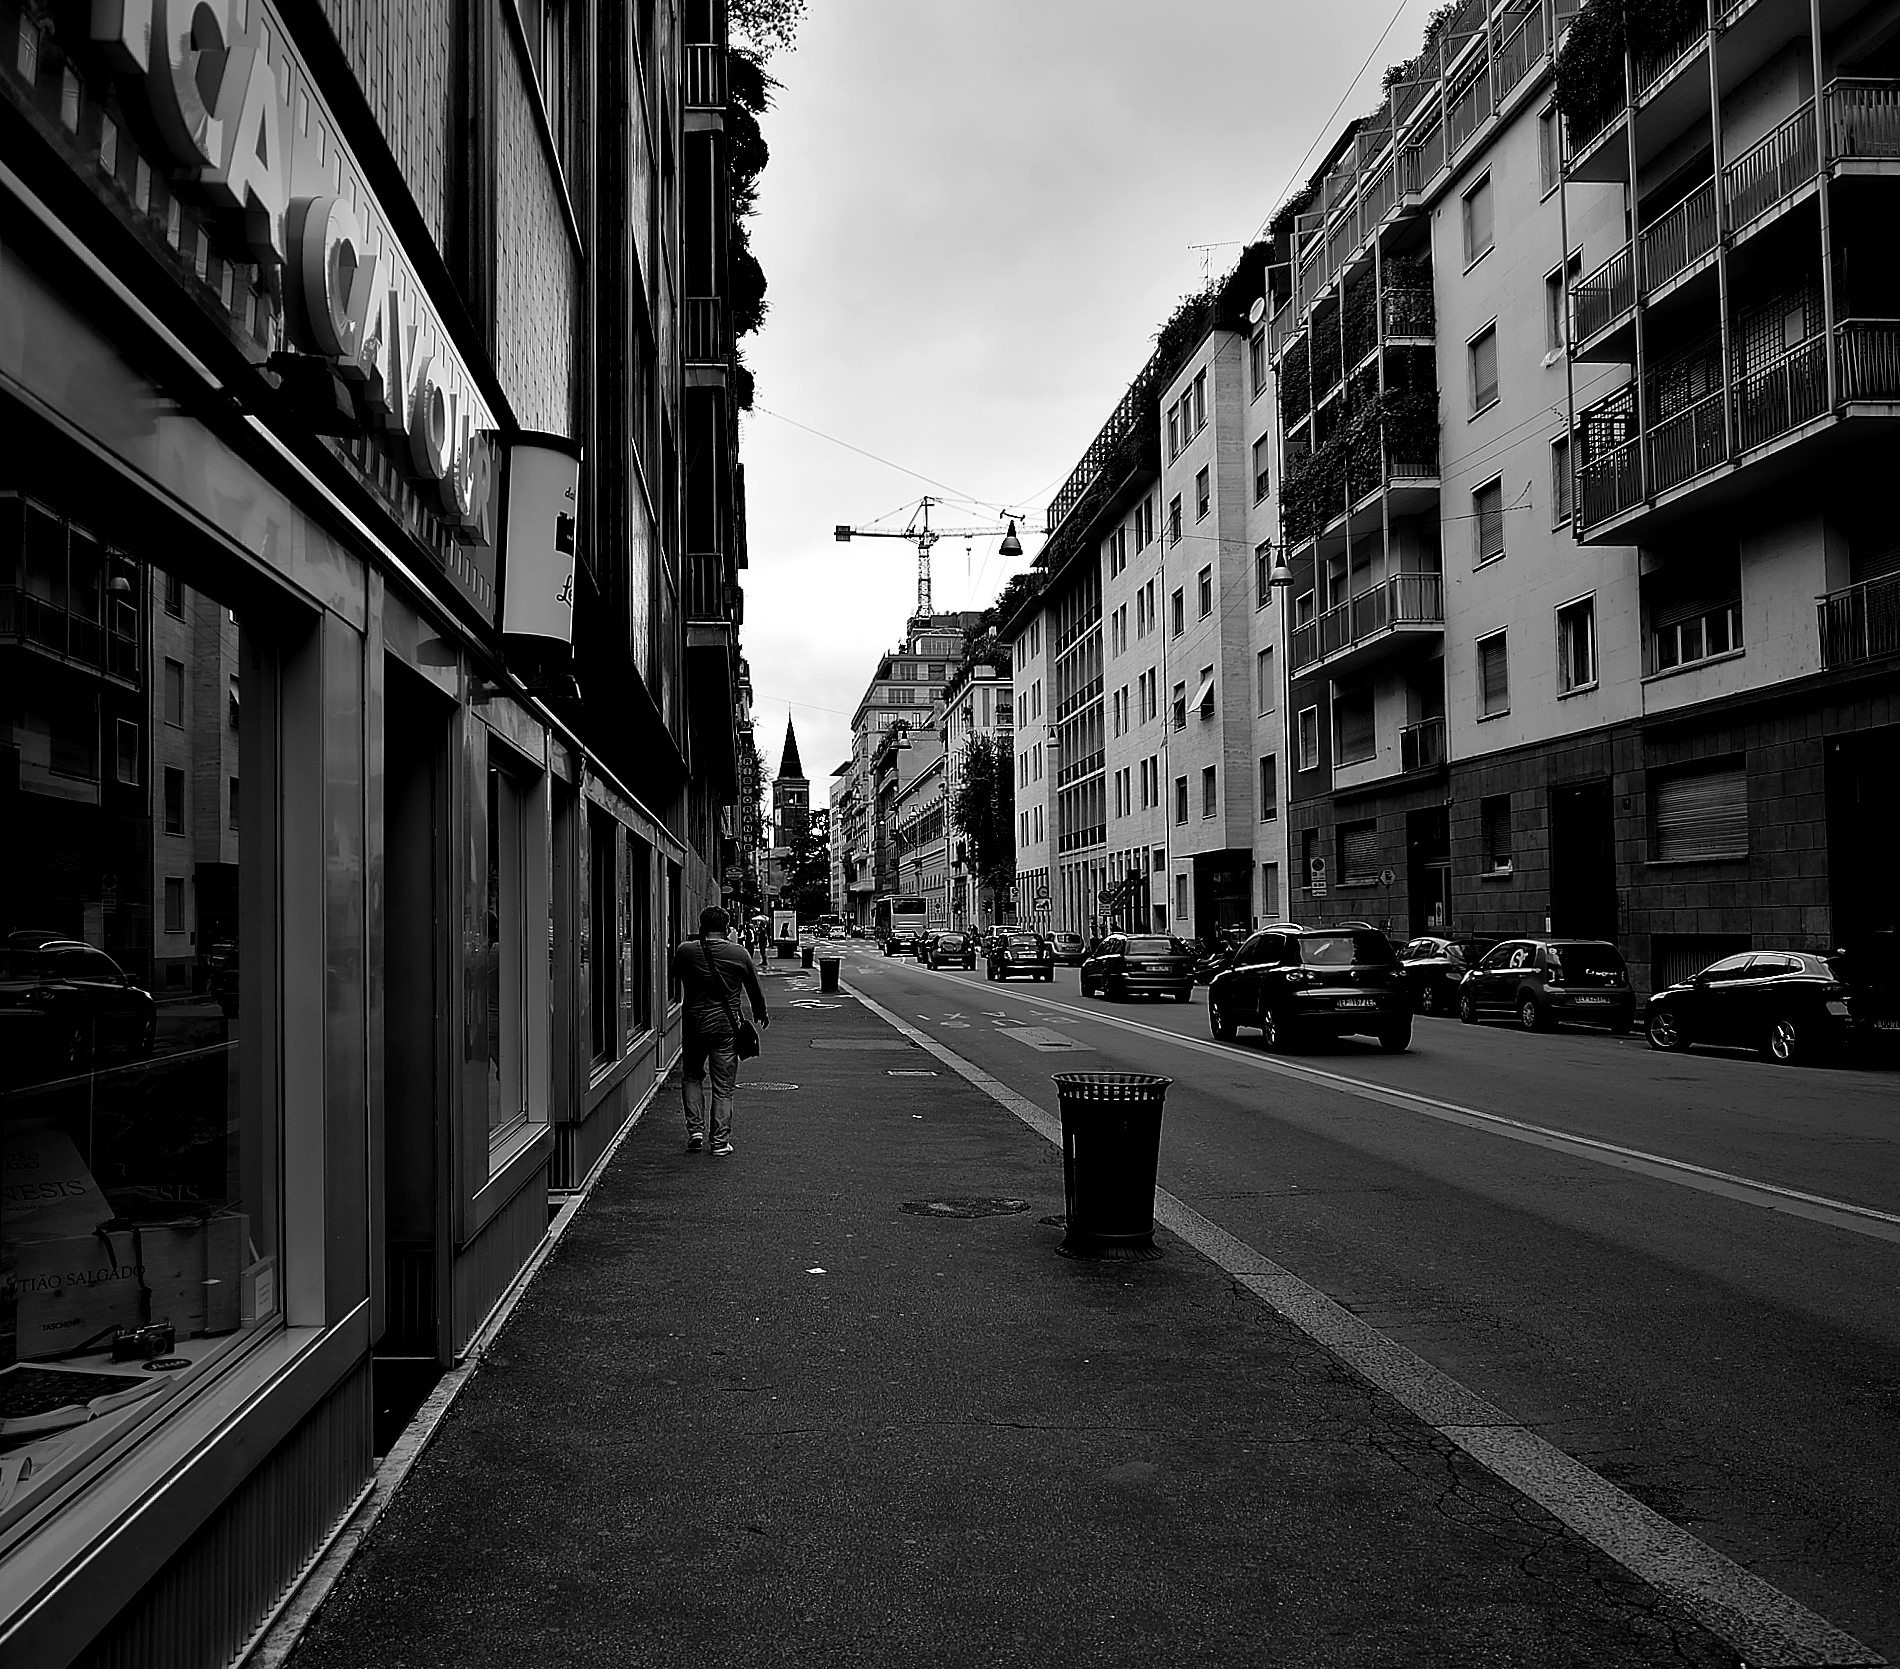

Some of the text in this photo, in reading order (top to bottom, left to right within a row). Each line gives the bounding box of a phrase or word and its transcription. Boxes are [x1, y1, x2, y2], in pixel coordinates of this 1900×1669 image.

[284, 195, 491, 548] CAVOUR
[742, 757, 754, 852] RISTORANTE
[66, 1264, 146, 1287] SALGADO
